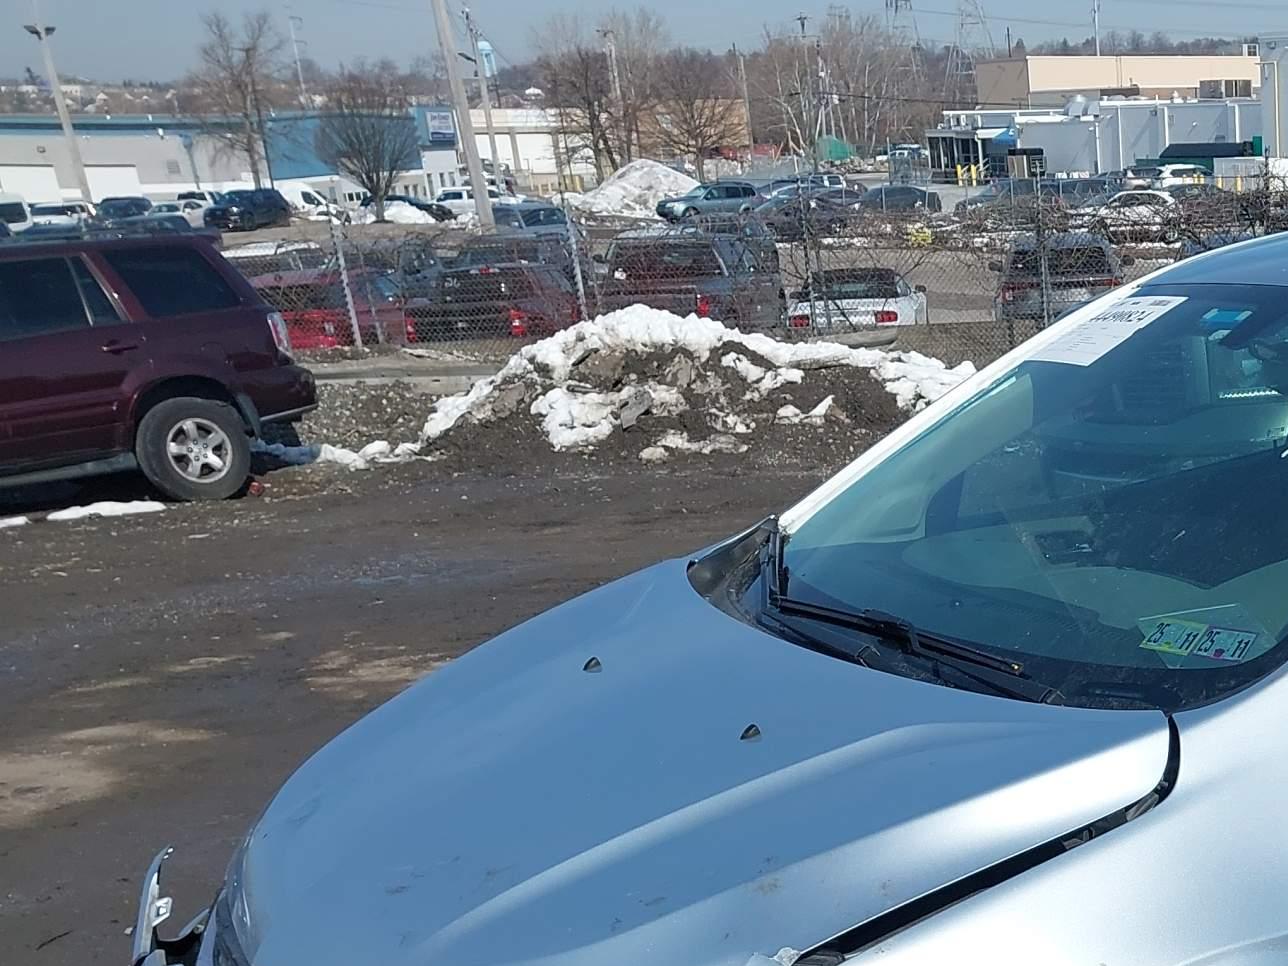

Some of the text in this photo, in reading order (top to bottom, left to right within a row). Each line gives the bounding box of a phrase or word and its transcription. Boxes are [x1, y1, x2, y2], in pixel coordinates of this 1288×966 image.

[1147, 623, 1200, 651] 25 11
[1199, 631, 1251, 659] 25 11
